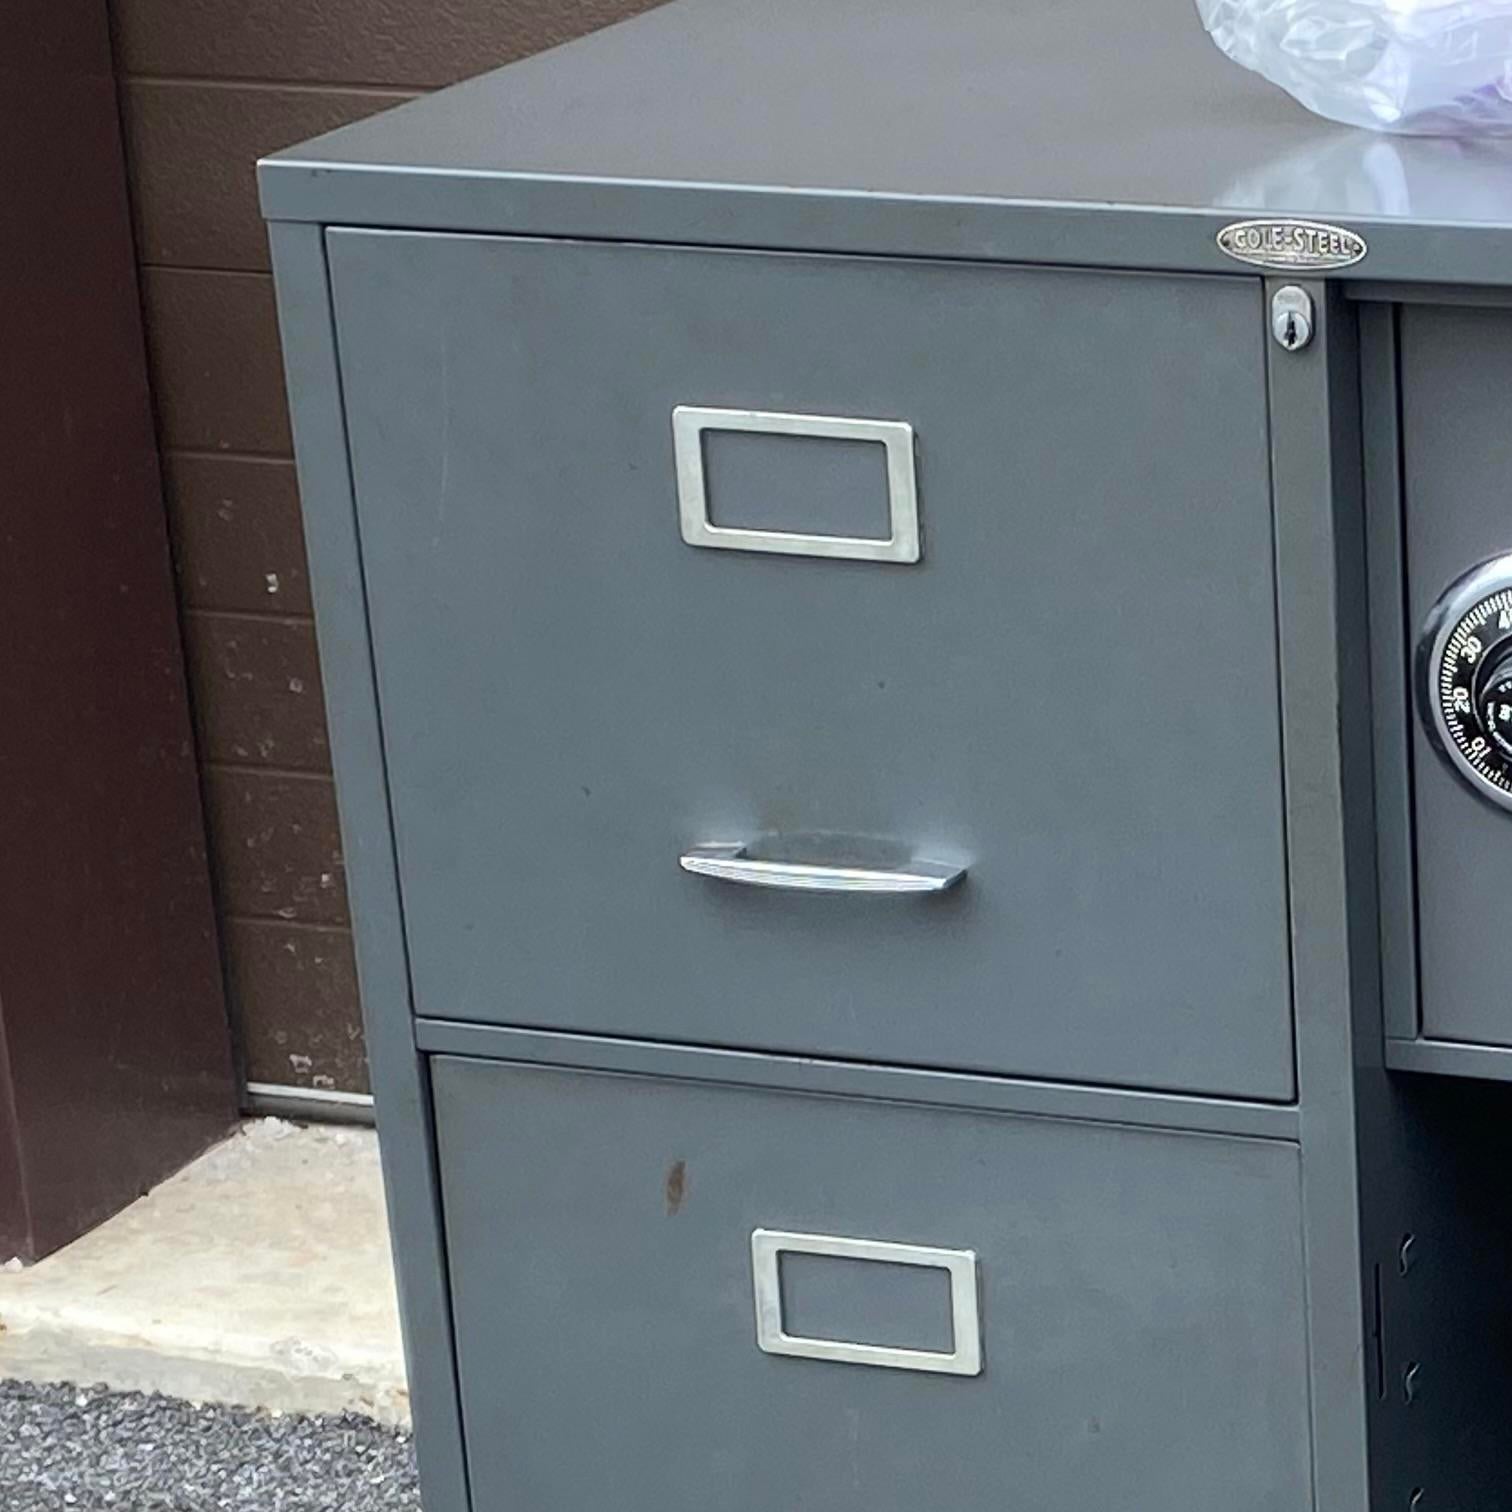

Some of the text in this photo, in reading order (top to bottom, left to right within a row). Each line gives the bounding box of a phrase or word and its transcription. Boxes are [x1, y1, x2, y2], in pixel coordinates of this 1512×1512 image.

[1461, 637, 1482, 663] 30
[1452, 687, 1471, 714] 20
[1472, 736, 1492, 758] 10
